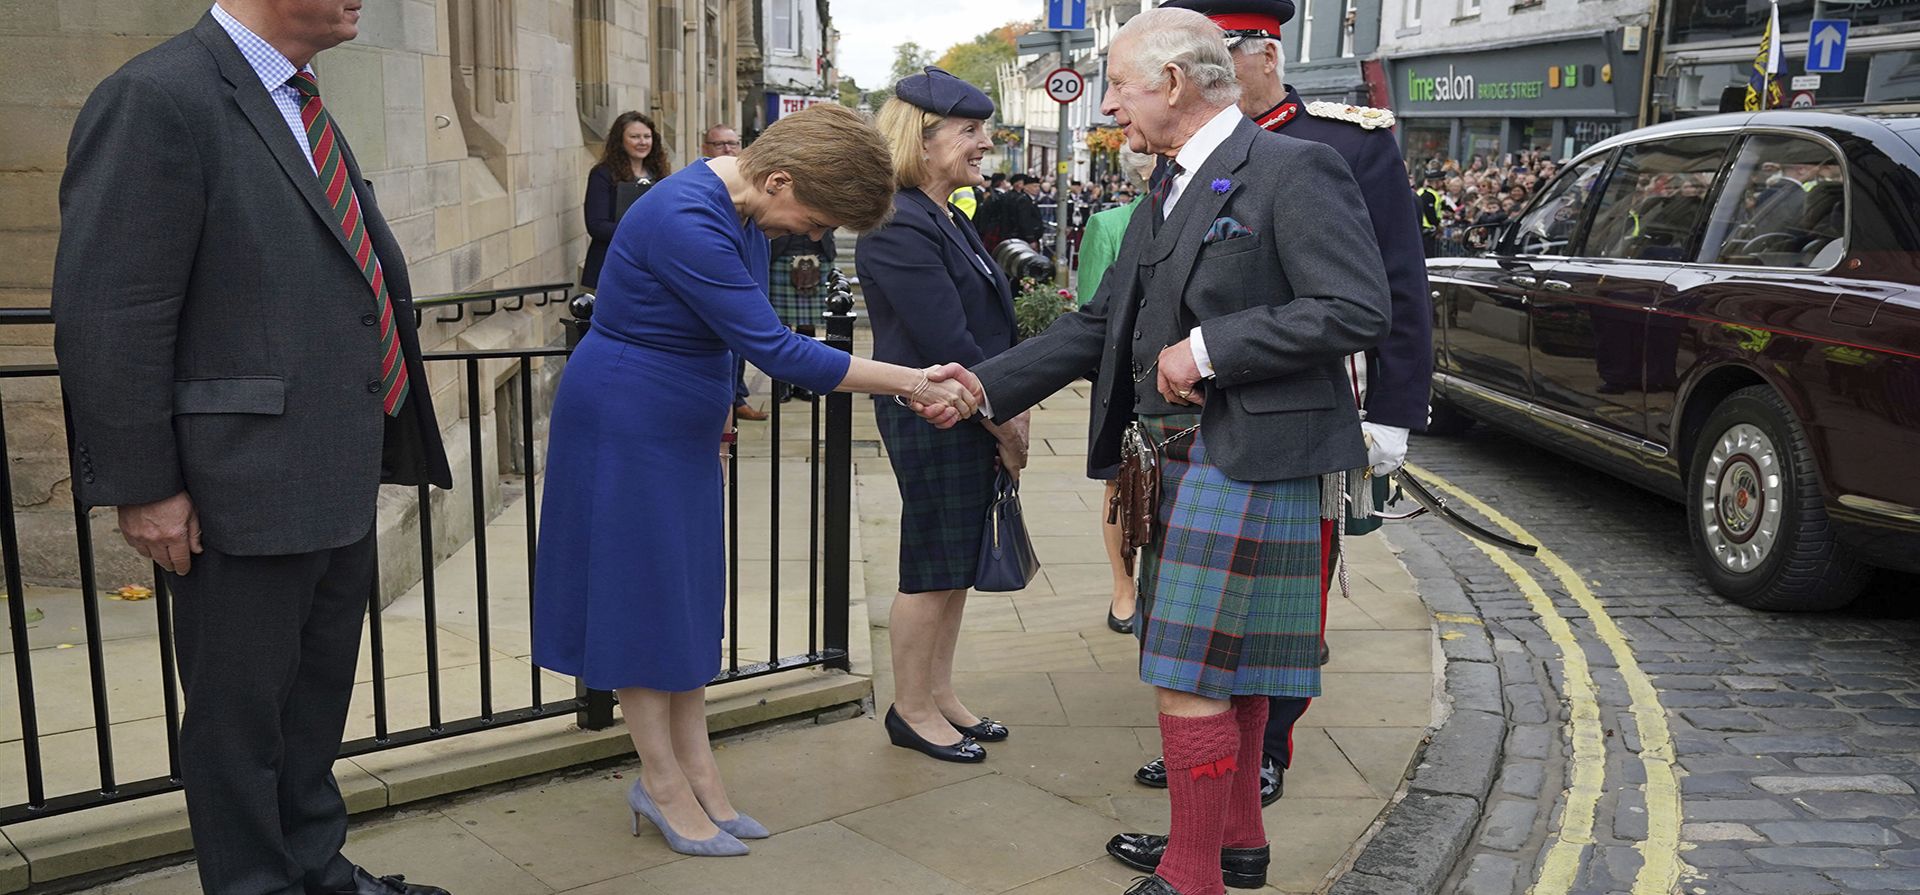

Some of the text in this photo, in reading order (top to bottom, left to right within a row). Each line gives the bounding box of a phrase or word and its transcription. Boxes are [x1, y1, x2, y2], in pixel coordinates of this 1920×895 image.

[1052, 79, 1078, 94] 20
[1478, 83, 1508, 99] BRIDGE
[1511, 81, 1543, 99] STREET
